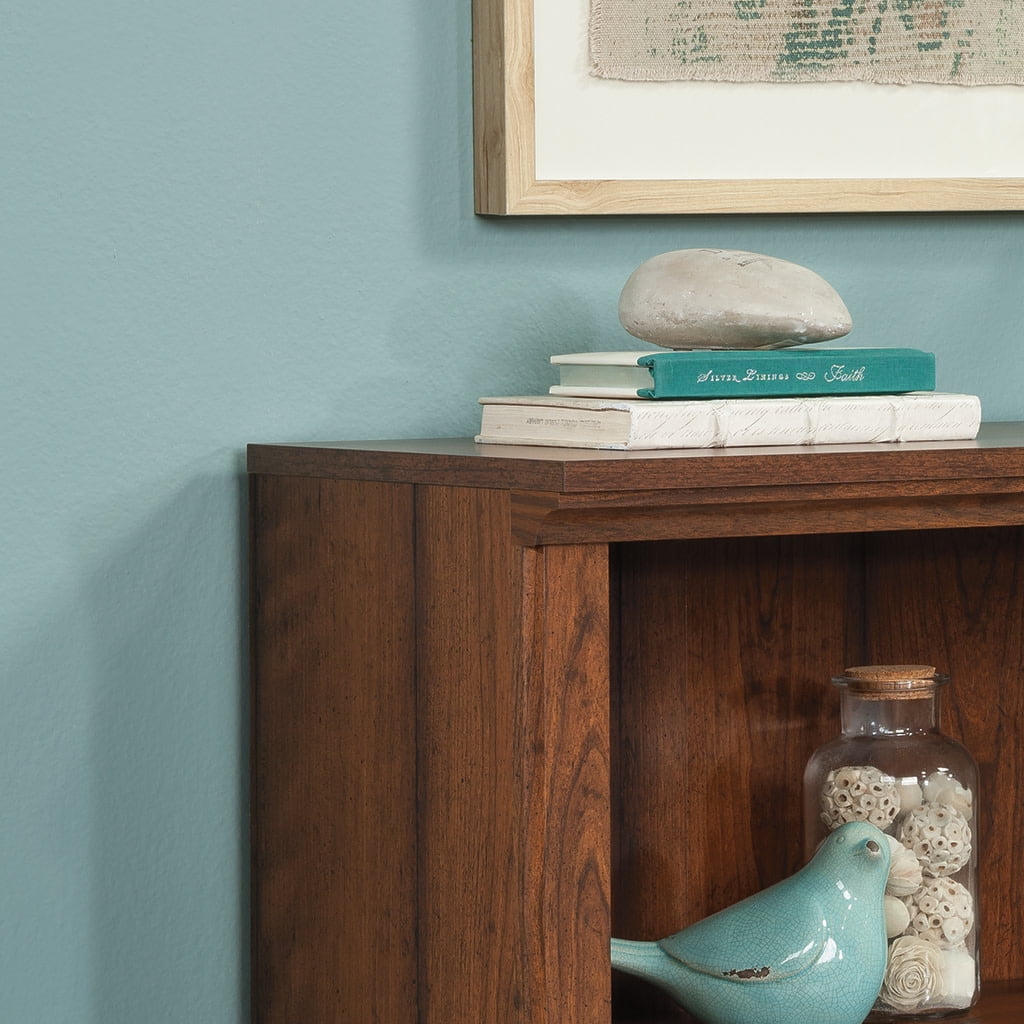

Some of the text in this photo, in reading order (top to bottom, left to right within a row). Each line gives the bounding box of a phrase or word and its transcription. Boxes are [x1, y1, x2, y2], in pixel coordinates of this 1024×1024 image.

[697, 364, 865, 383] SILVER LININGS Faith
